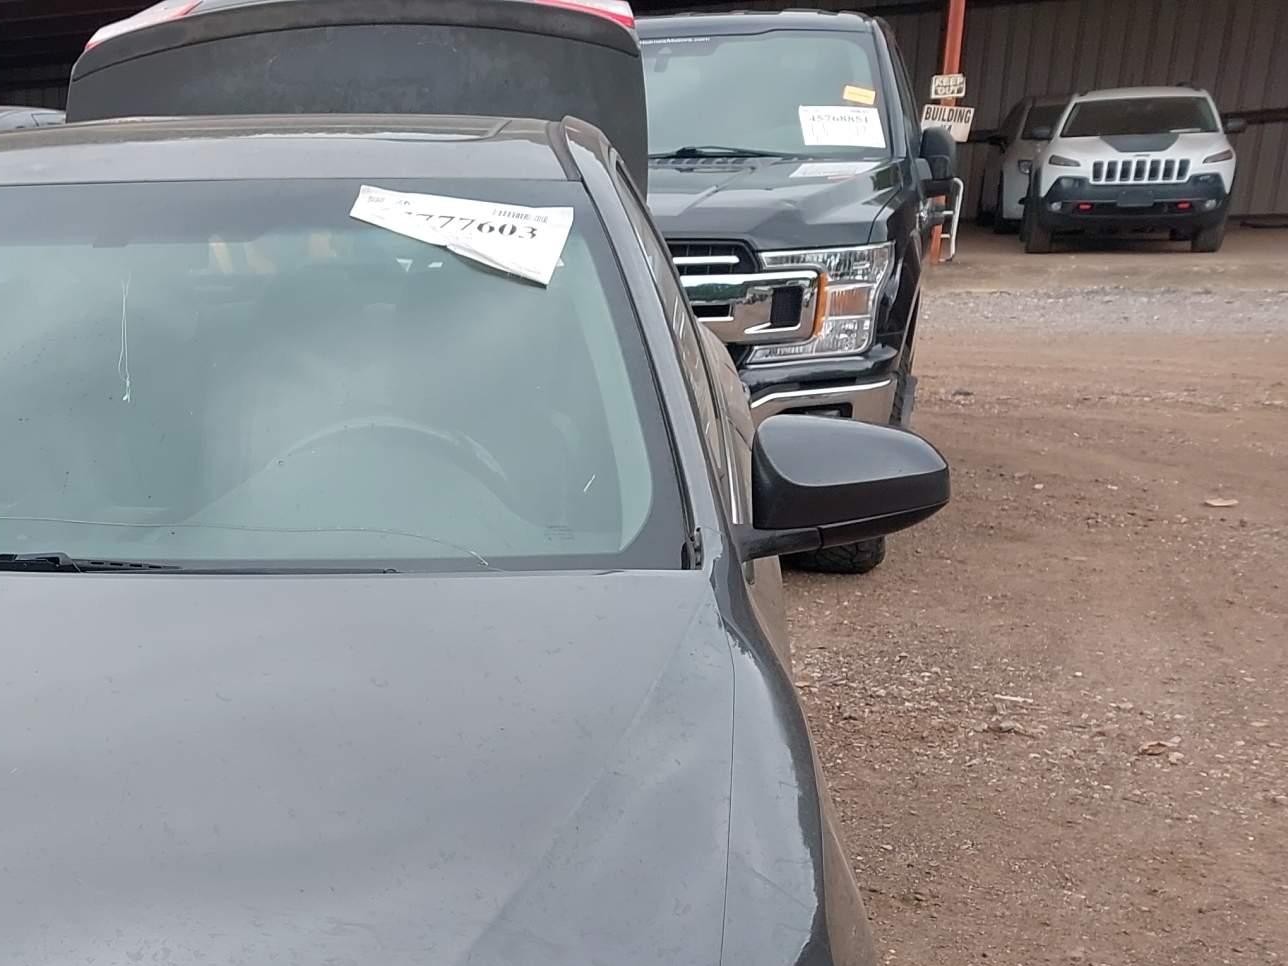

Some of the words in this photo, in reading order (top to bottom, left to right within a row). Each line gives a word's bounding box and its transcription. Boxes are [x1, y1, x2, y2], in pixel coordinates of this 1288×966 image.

[935, 76, 964, 87] KEEP
[937, 86, 960, 95] OUT
[925, 106, 972, 124] BUILDING
